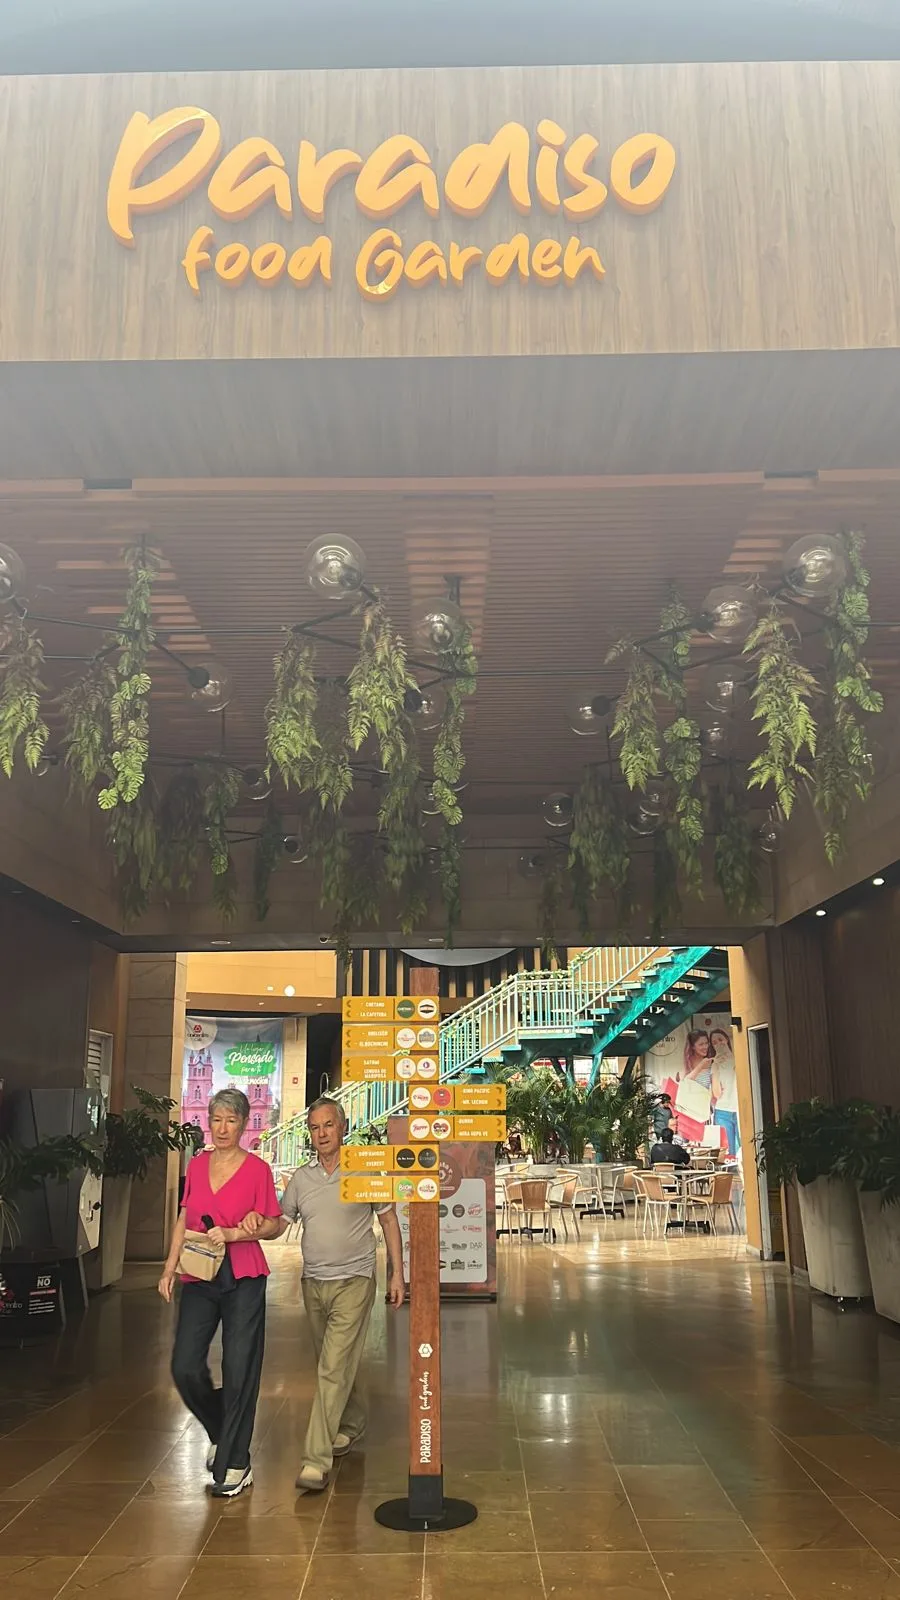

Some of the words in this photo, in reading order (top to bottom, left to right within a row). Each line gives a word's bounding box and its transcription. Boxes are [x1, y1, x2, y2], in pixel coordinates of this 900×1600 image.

[107, 107, 676, 248] Paradiso
[181, 226, 332, 294] food
[355, 228, 606, 301] Garden
[229, 1050, 274, 1066] Pensado
[37, 1278, 51, 1286] NO
